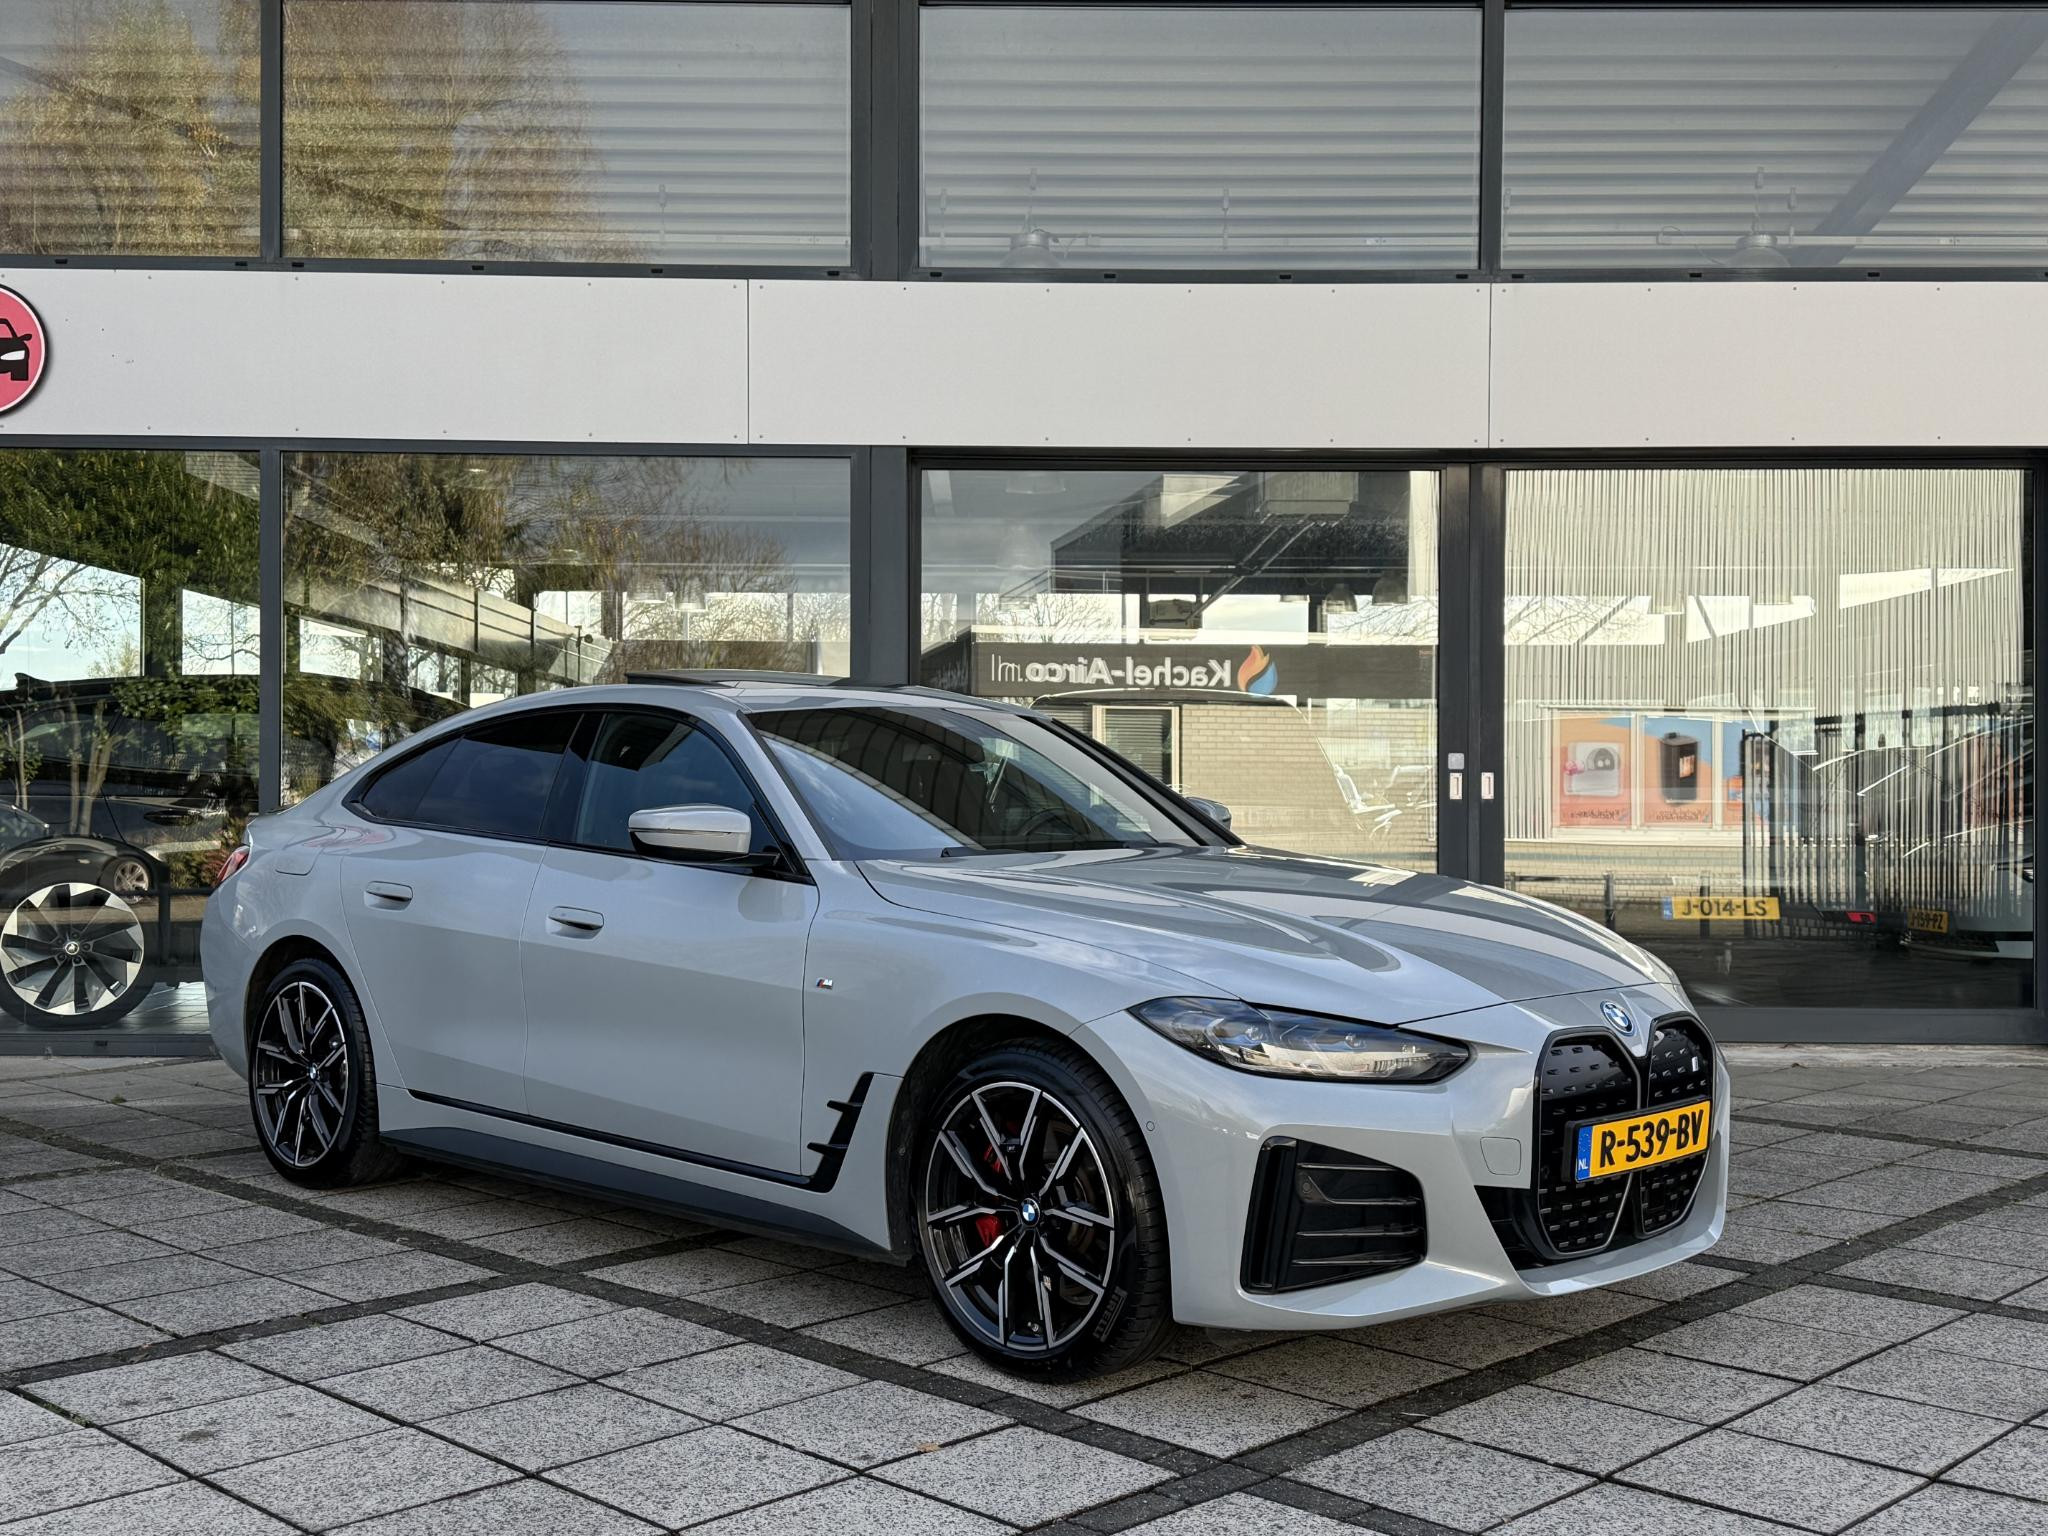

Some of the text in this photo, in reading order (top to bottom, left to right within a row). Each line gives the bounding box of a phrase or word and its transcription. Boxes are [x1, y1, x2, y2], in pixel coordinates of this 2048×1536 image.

[1682, 900, 1767, 916] J-014-LS
[1578, 1109, 1704, 1170] NL R-539-BV
